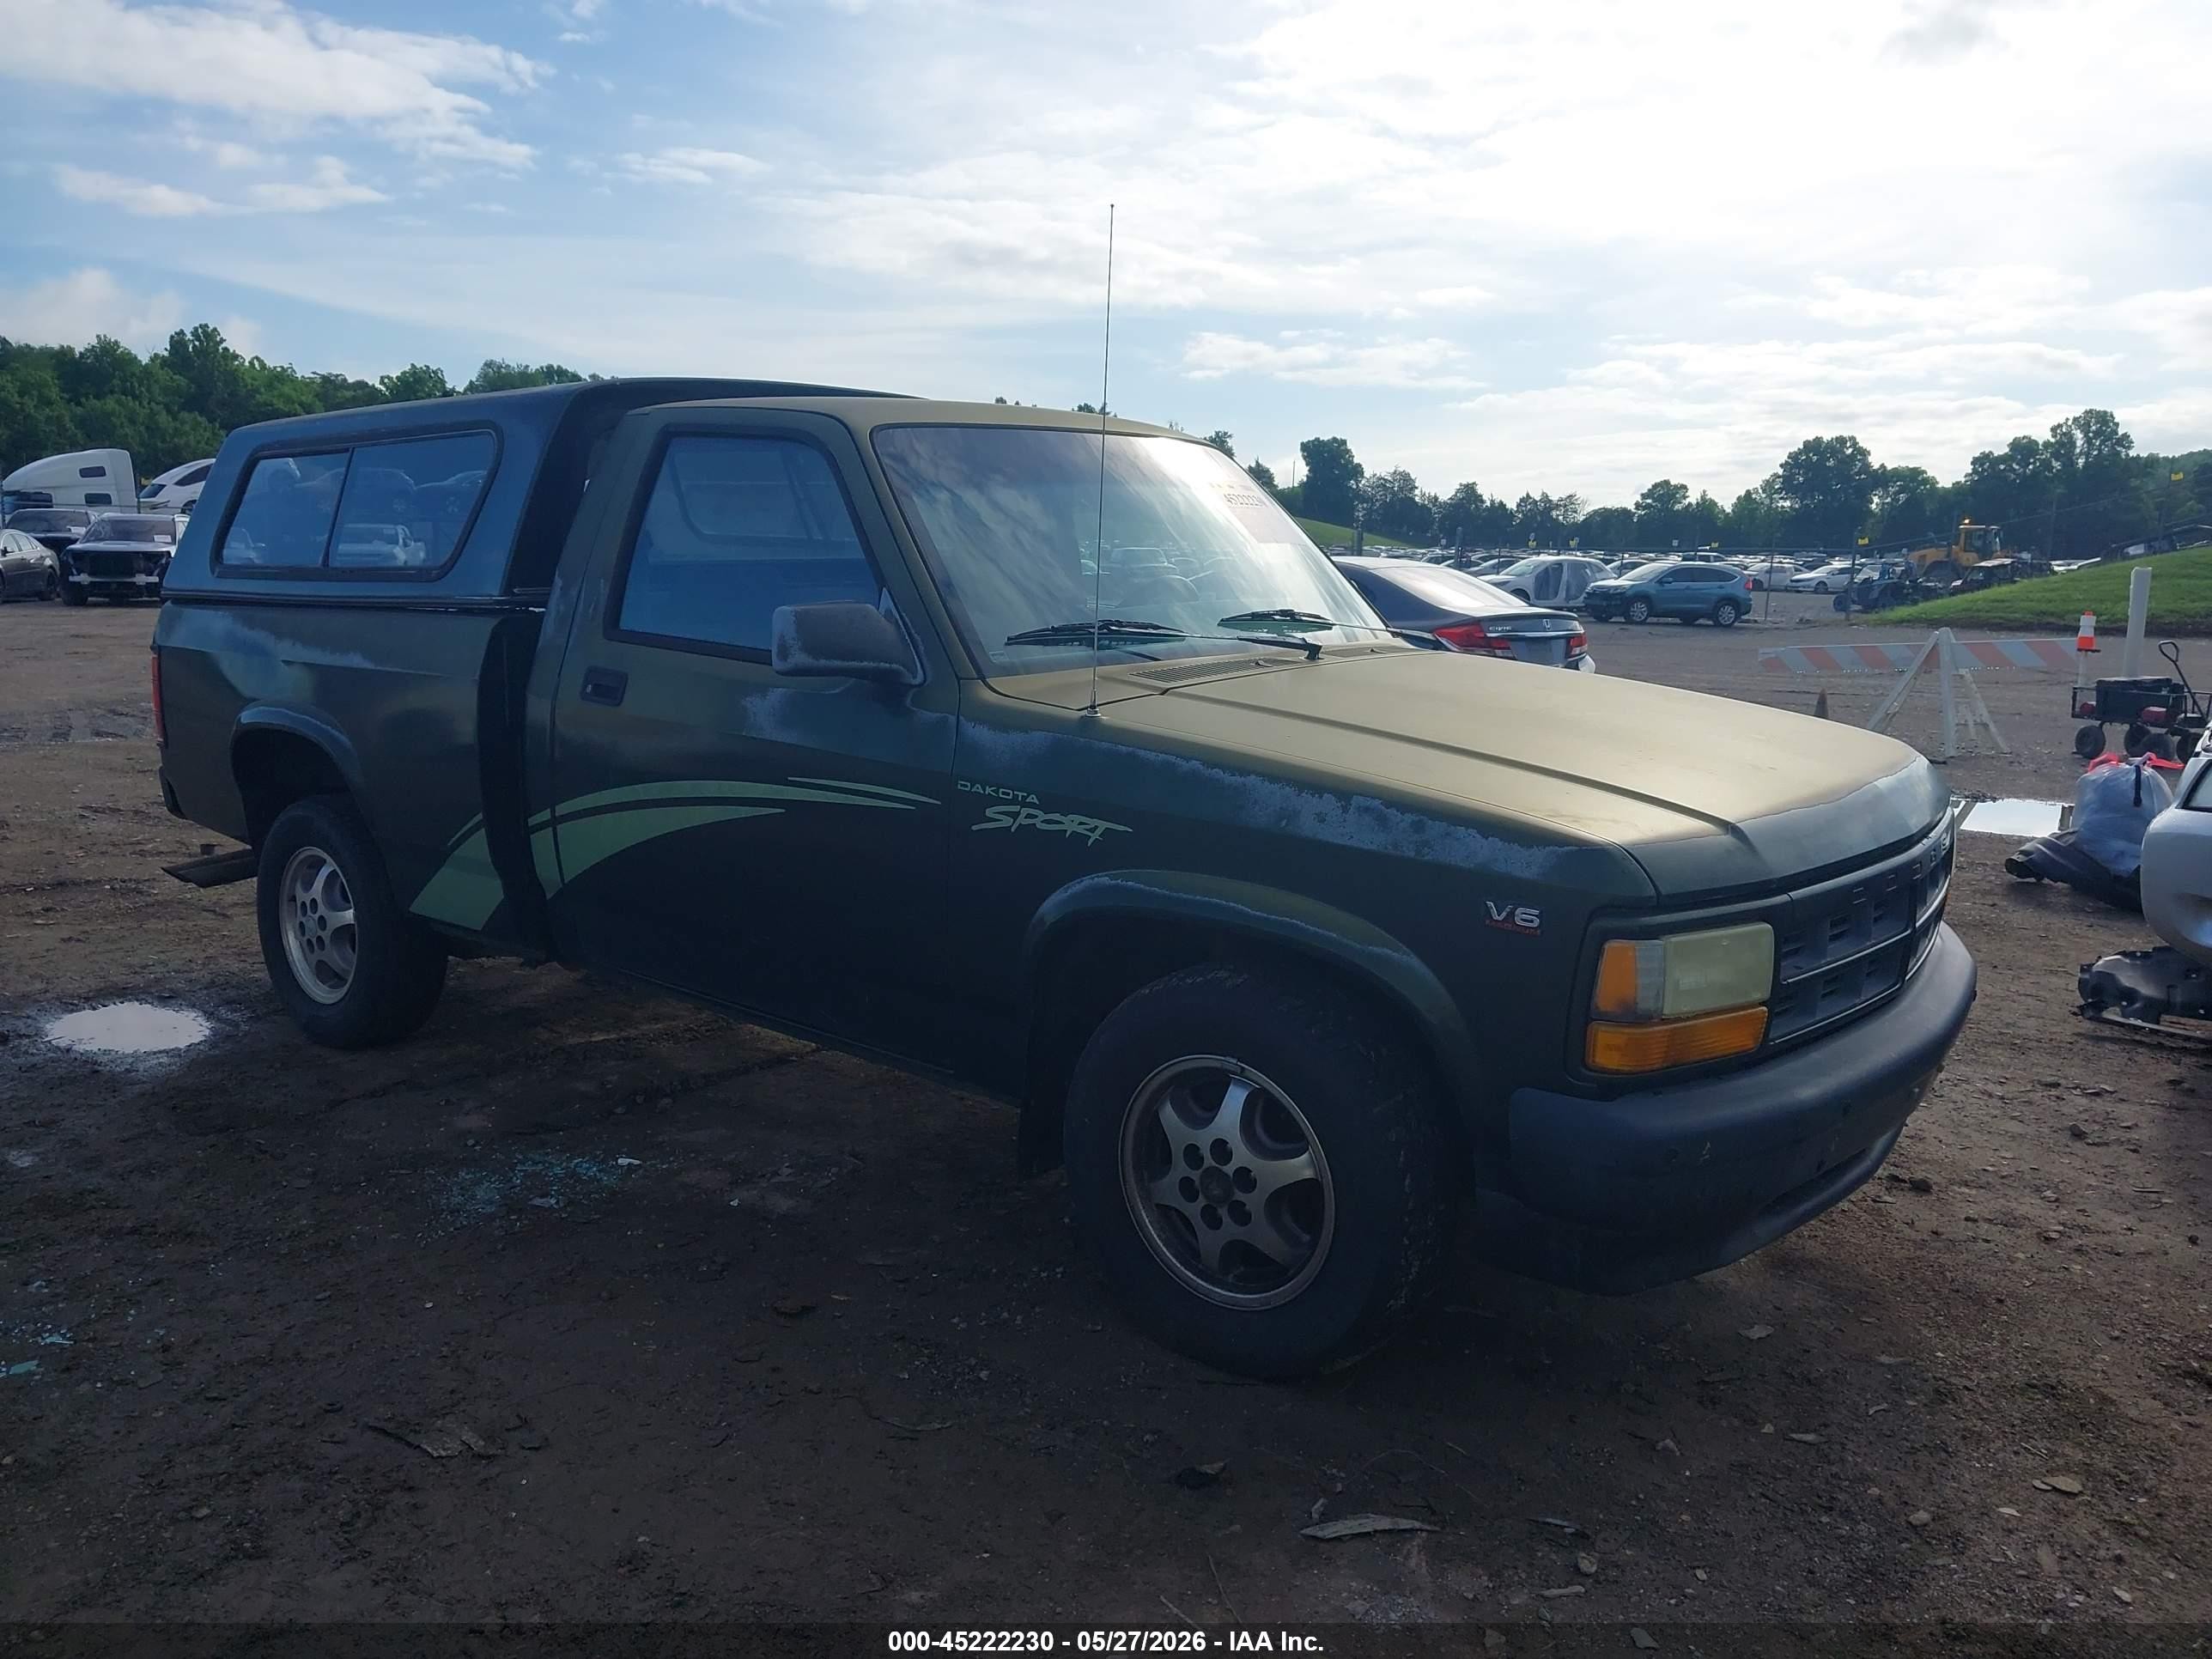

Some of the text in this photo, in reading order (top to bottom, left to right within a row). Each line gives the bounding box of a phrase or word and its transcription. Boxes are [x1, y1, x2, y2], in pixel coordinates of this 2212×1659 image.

[957, 780, 1040, 805] DAKOTA
[970, 805, 1133, 847] SPORT
[1485, 901, 1540, 928] V6
